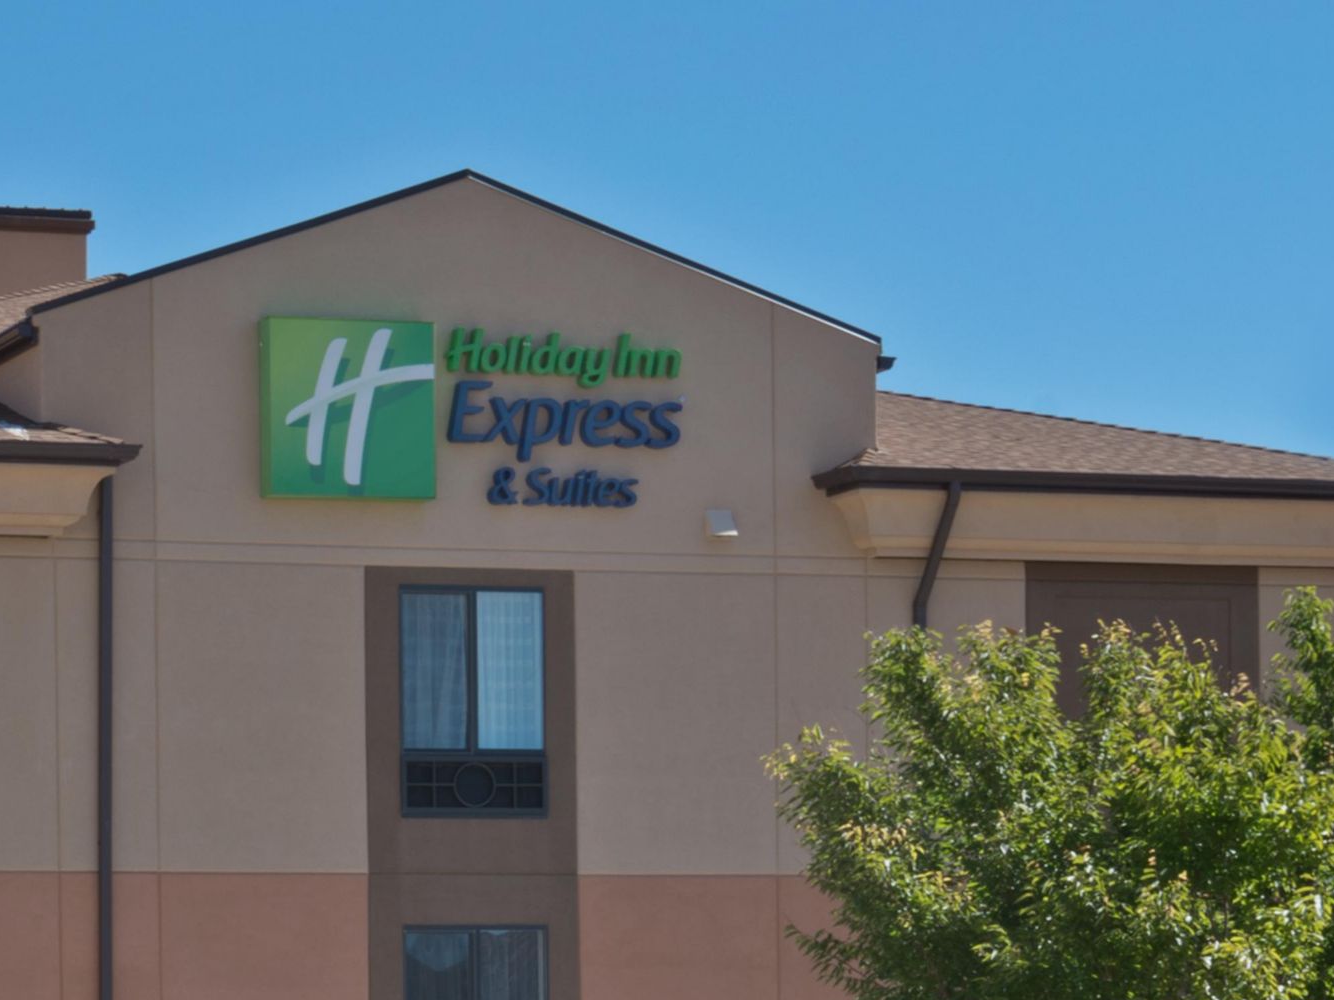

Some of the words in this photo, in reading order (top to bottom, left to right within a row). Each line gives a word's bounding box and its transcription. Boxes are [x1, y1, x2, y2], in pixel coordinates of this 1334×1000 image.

[446, 327, 611, 388] Holiday
[613, 332, 682, 379] Inn
[447, 380, 683, 462] Express
[487, 467, 517, 505] &
[523, 467, 639, 508] Suites
